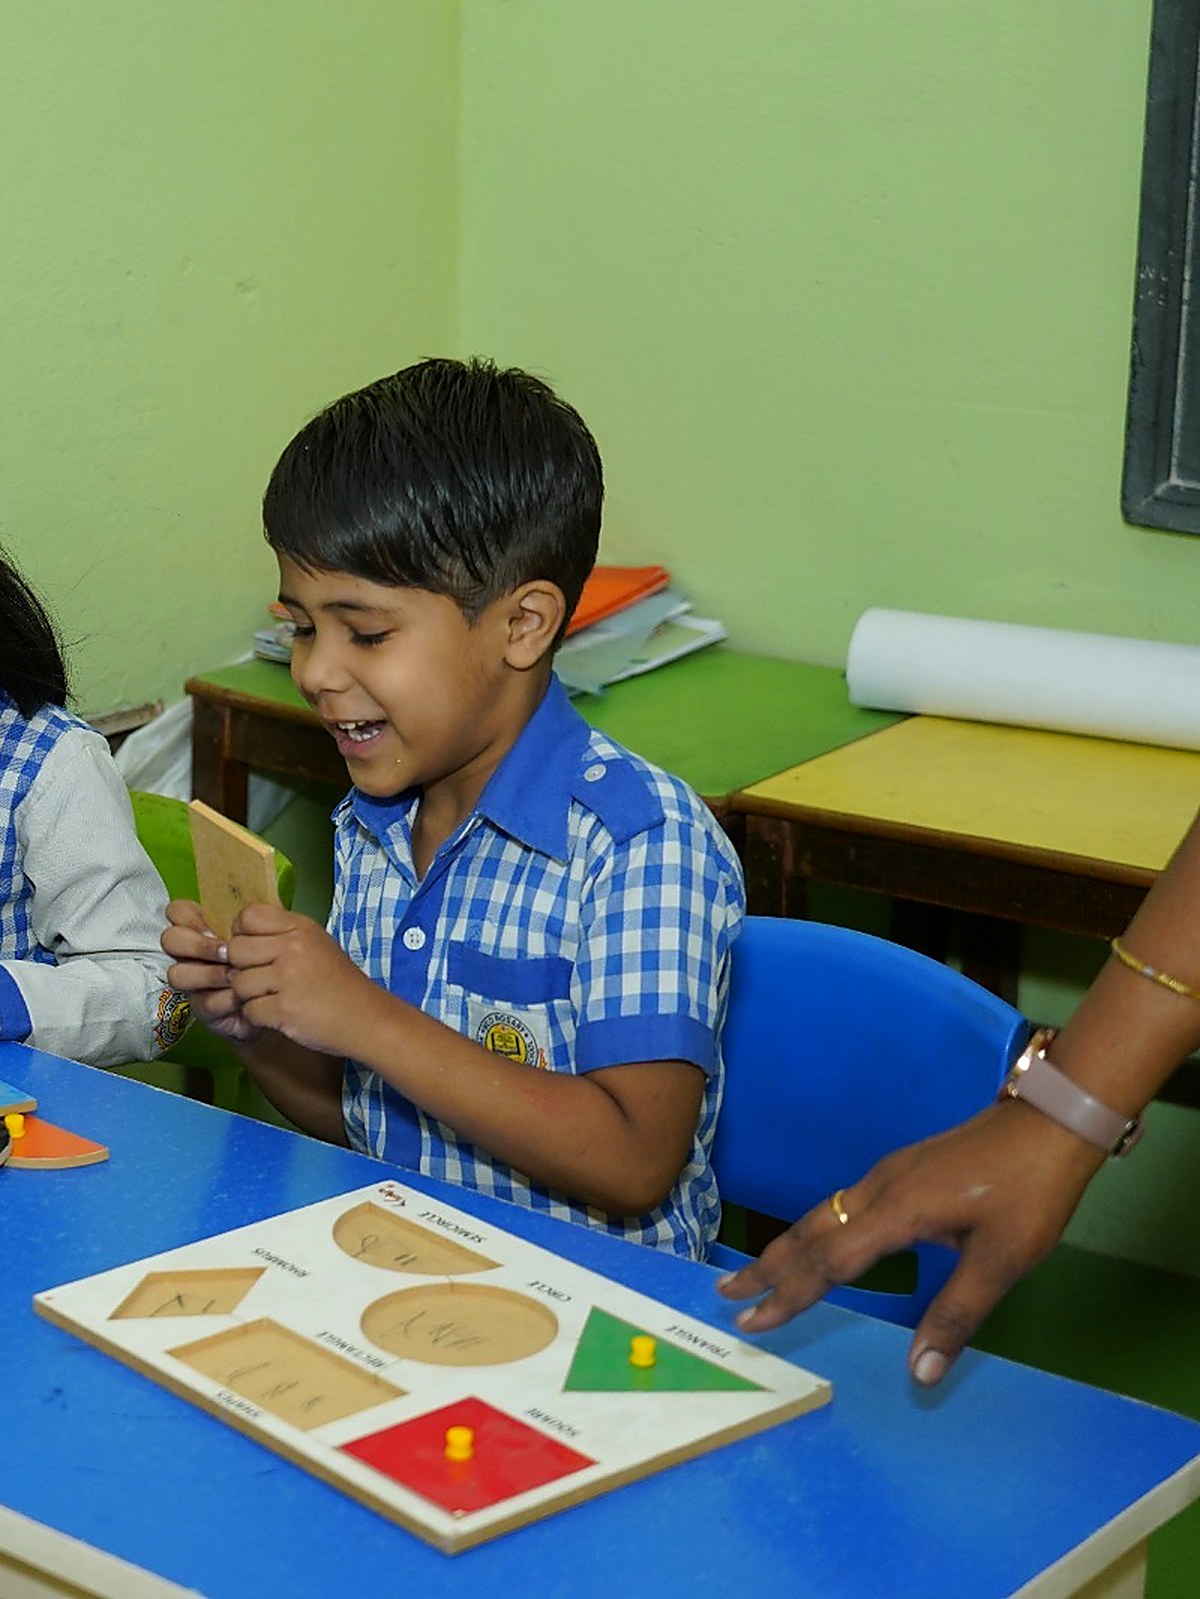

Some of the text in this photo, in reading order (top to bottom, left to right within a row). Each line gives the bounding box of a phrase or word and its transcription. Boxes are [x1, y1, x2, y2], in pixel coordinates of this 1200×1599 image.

[417, 1210, 487, 1245] SEMICIRCLE
[526, 1280, 572, 1303] CIRCLE
[314, 1331, 386, 1370] RECTANGLE
[665, 1325, 731, 1359] TRIANGLE
[524, 1408, 579, 1439] SQUARE
